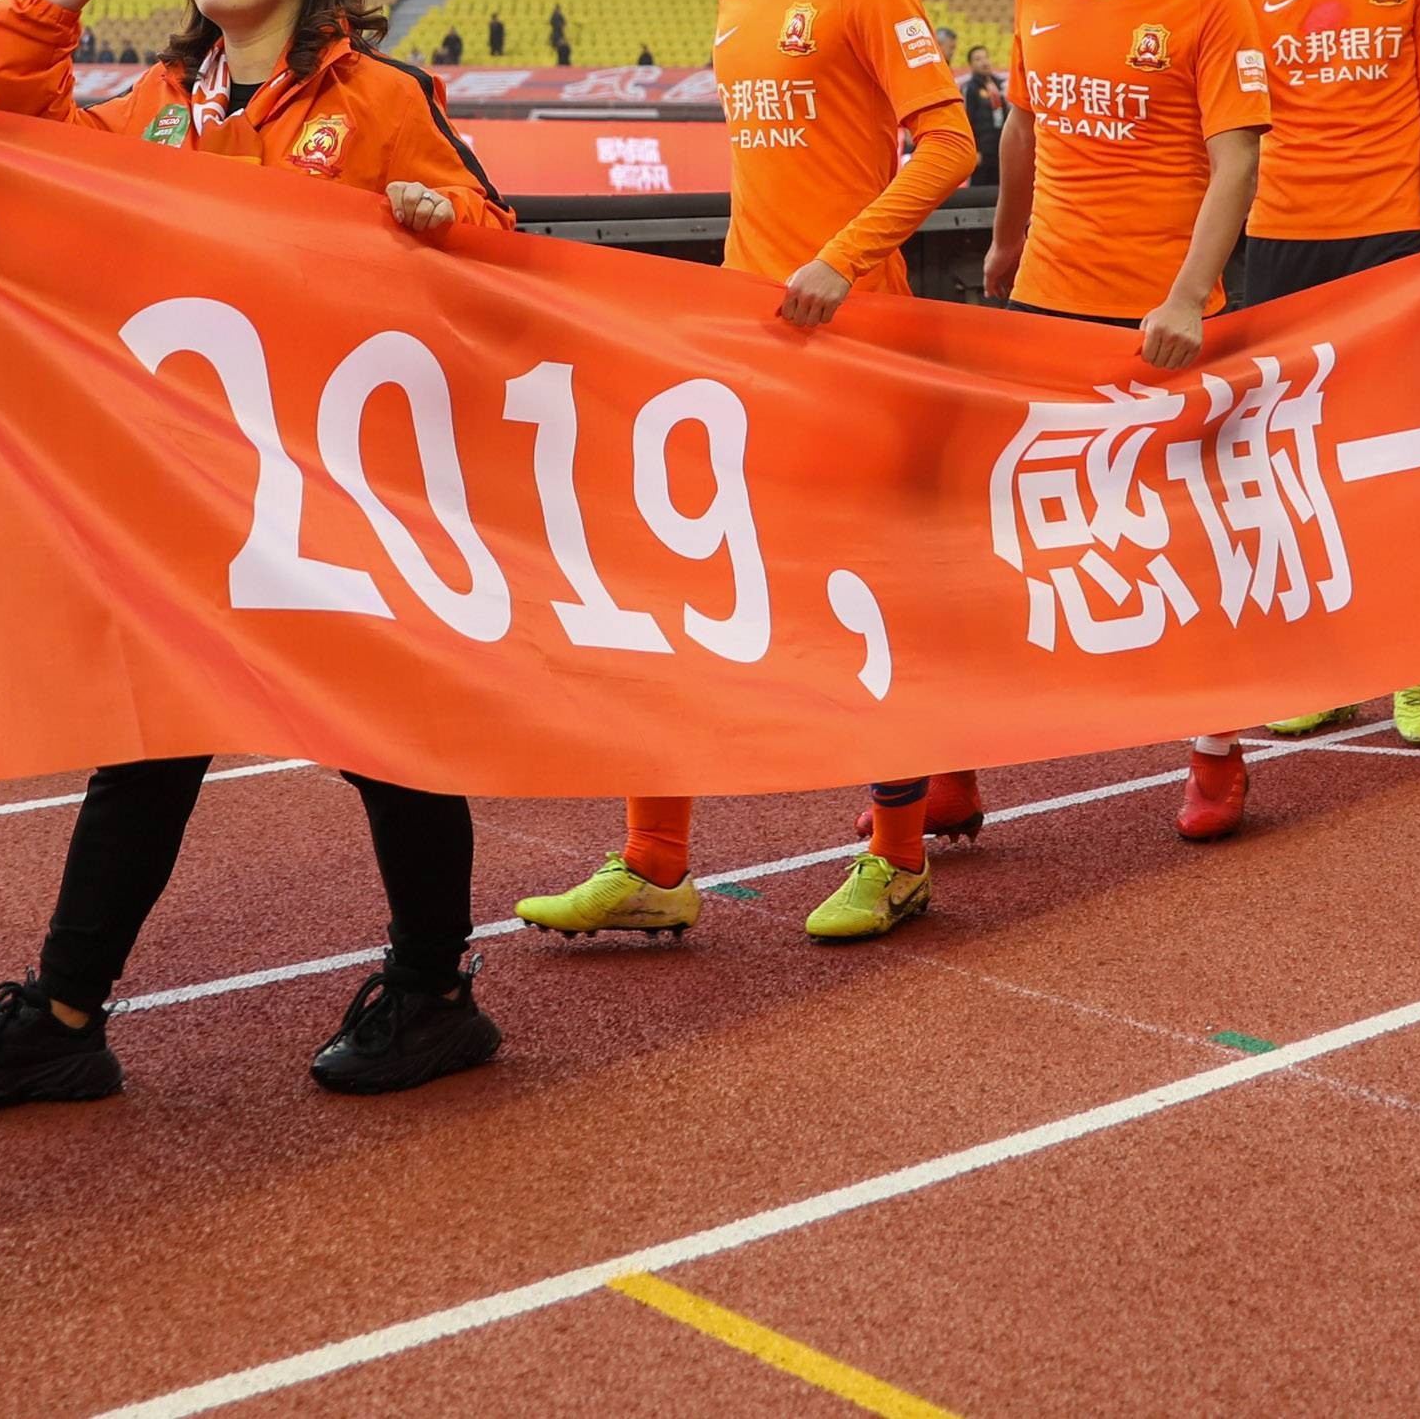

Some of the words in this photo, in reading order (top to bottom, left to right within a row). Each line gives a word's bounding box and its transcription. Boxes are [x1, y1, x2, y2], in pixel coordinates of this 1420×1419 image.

[1272, 26, 1403, 66] 众邦银行
[1288, 63, 1389, 86] Z-BANK
